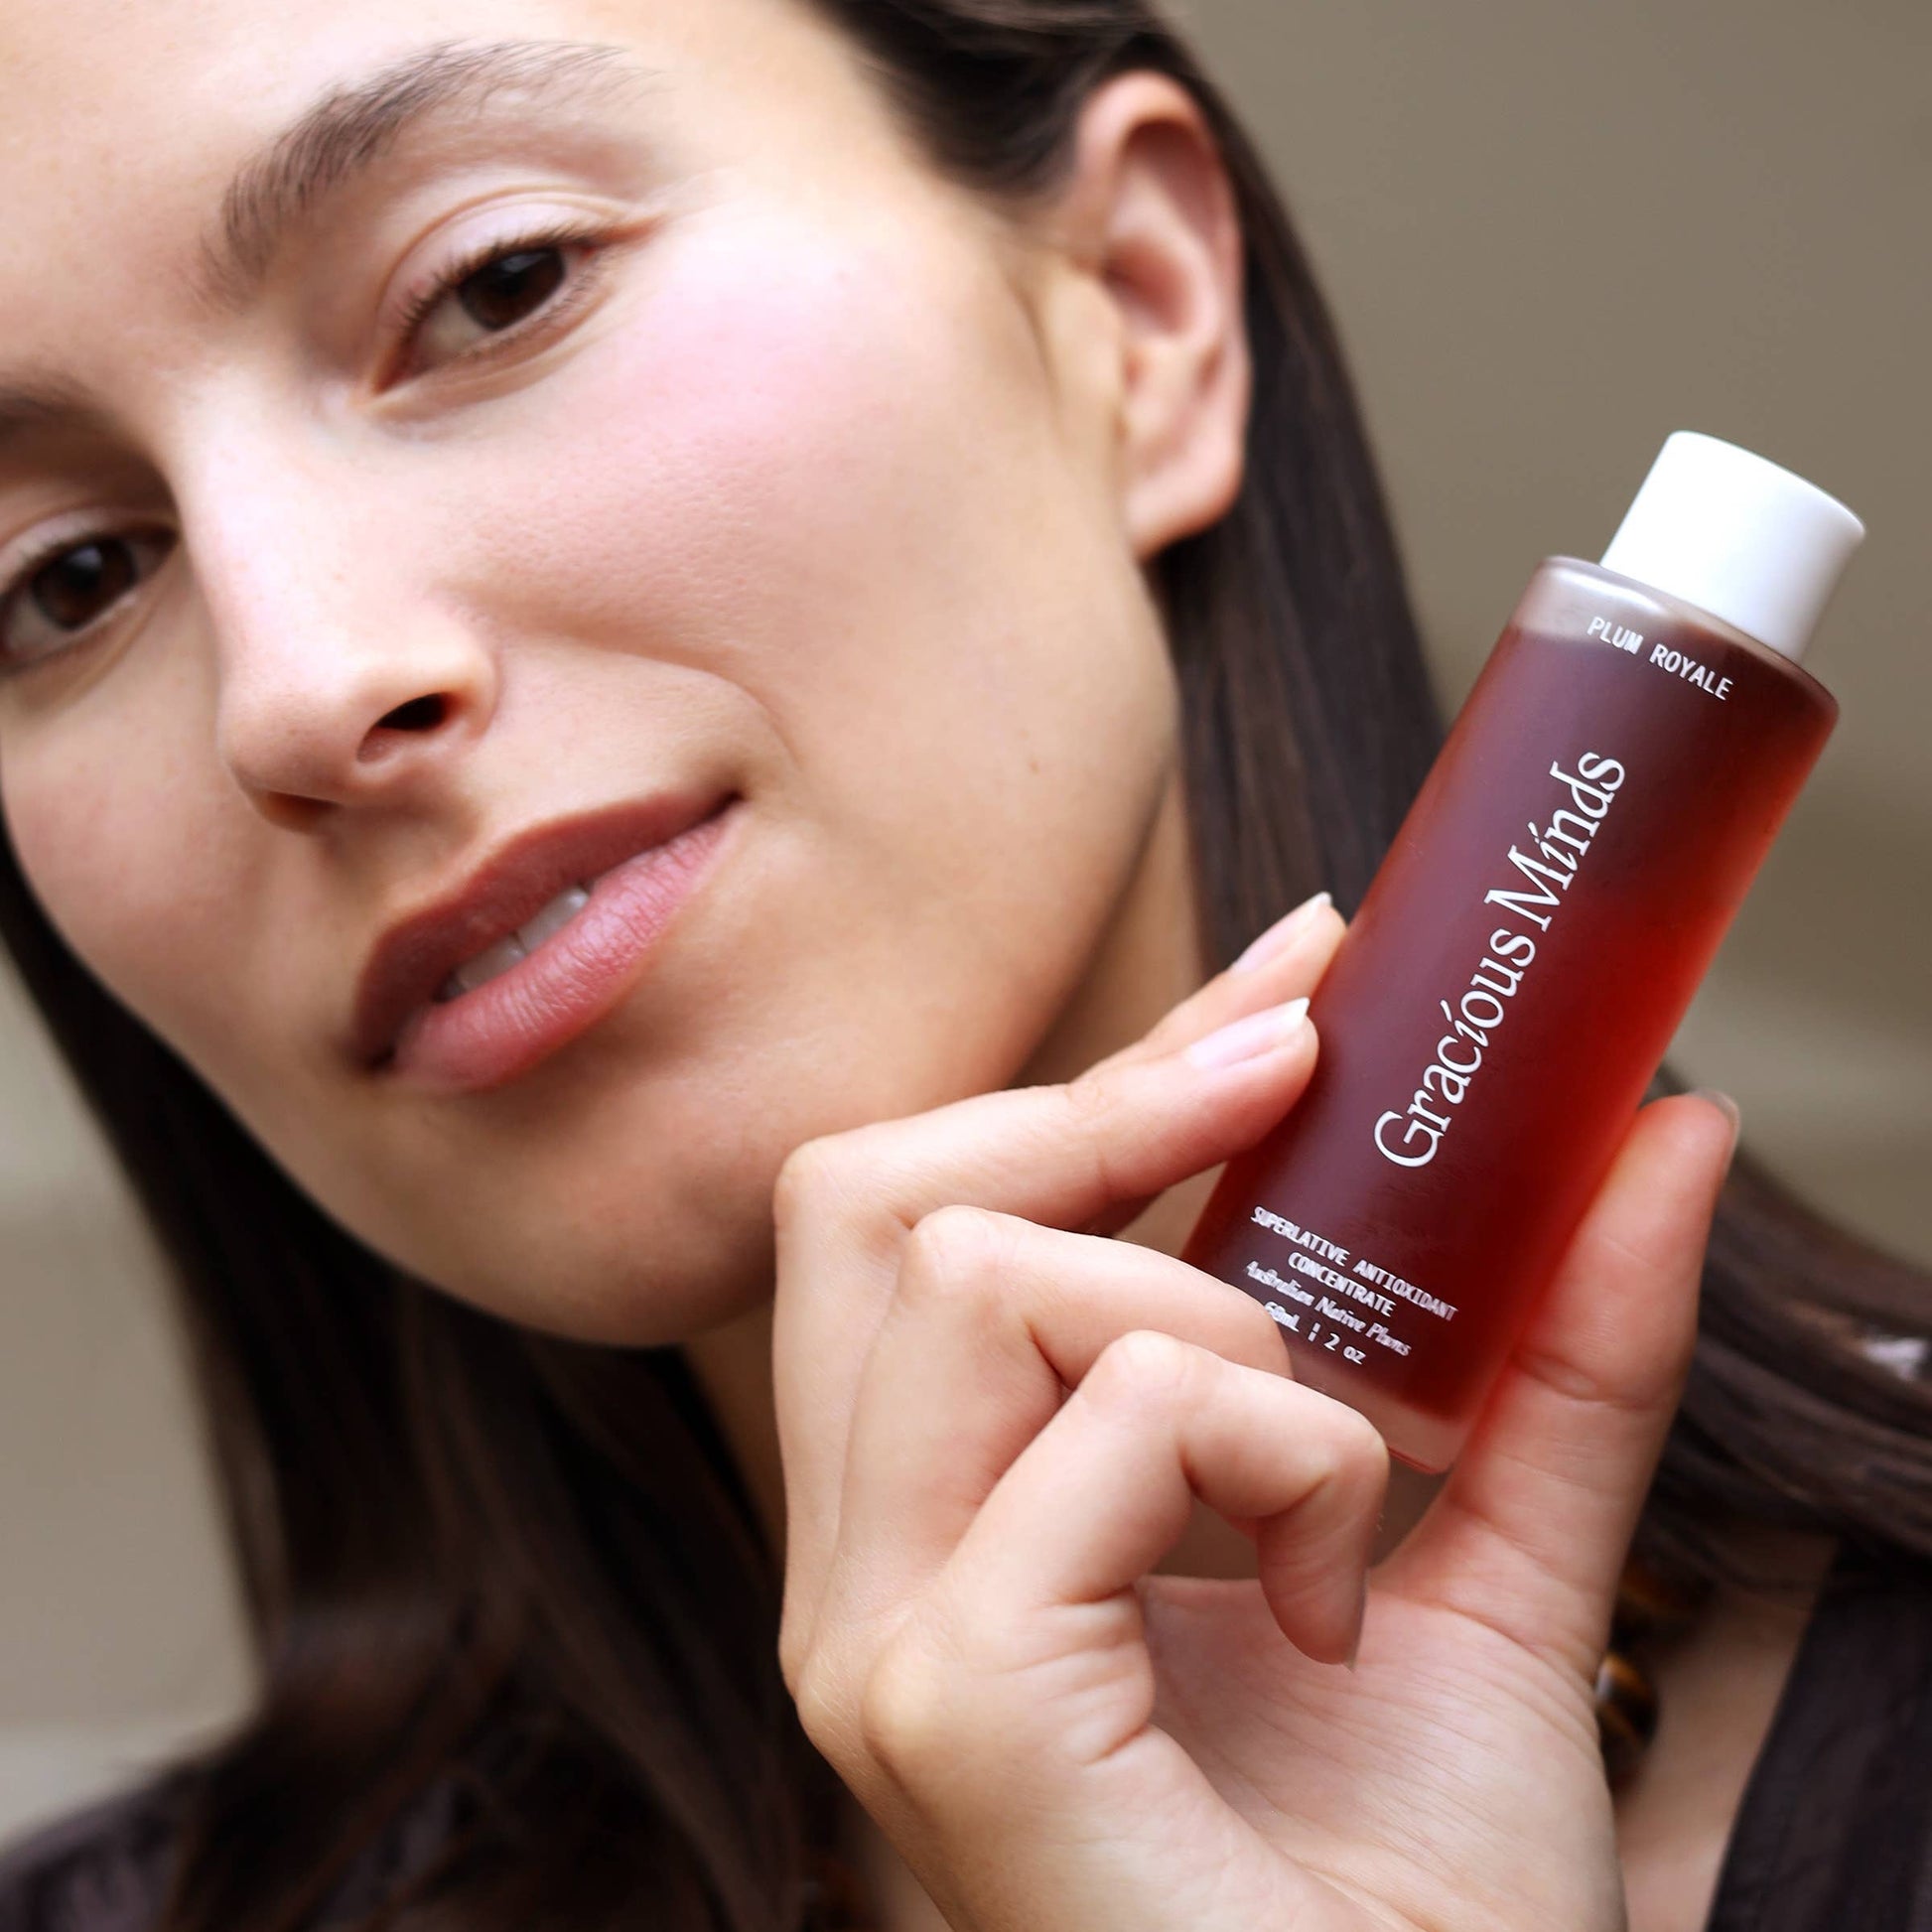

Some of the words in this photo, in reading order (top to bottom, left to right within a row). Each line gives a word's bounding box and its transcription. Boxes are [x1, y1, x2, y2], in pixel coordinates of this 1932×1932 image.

[1587, 617, 1644, 655] PLUM
[1649, 643, 1733, 701] ROYALE
[1250, 1206, 1351, 1267] SUPERLATIVE
[1352, 1259, 1458, 1321] ANTIOXIDANT
[1288, 1252, 1397, 1317] CONCENTRATE
[1313, 1296, 1366, 1332] Native
[1323, 1332, 1340, 1351] 2
